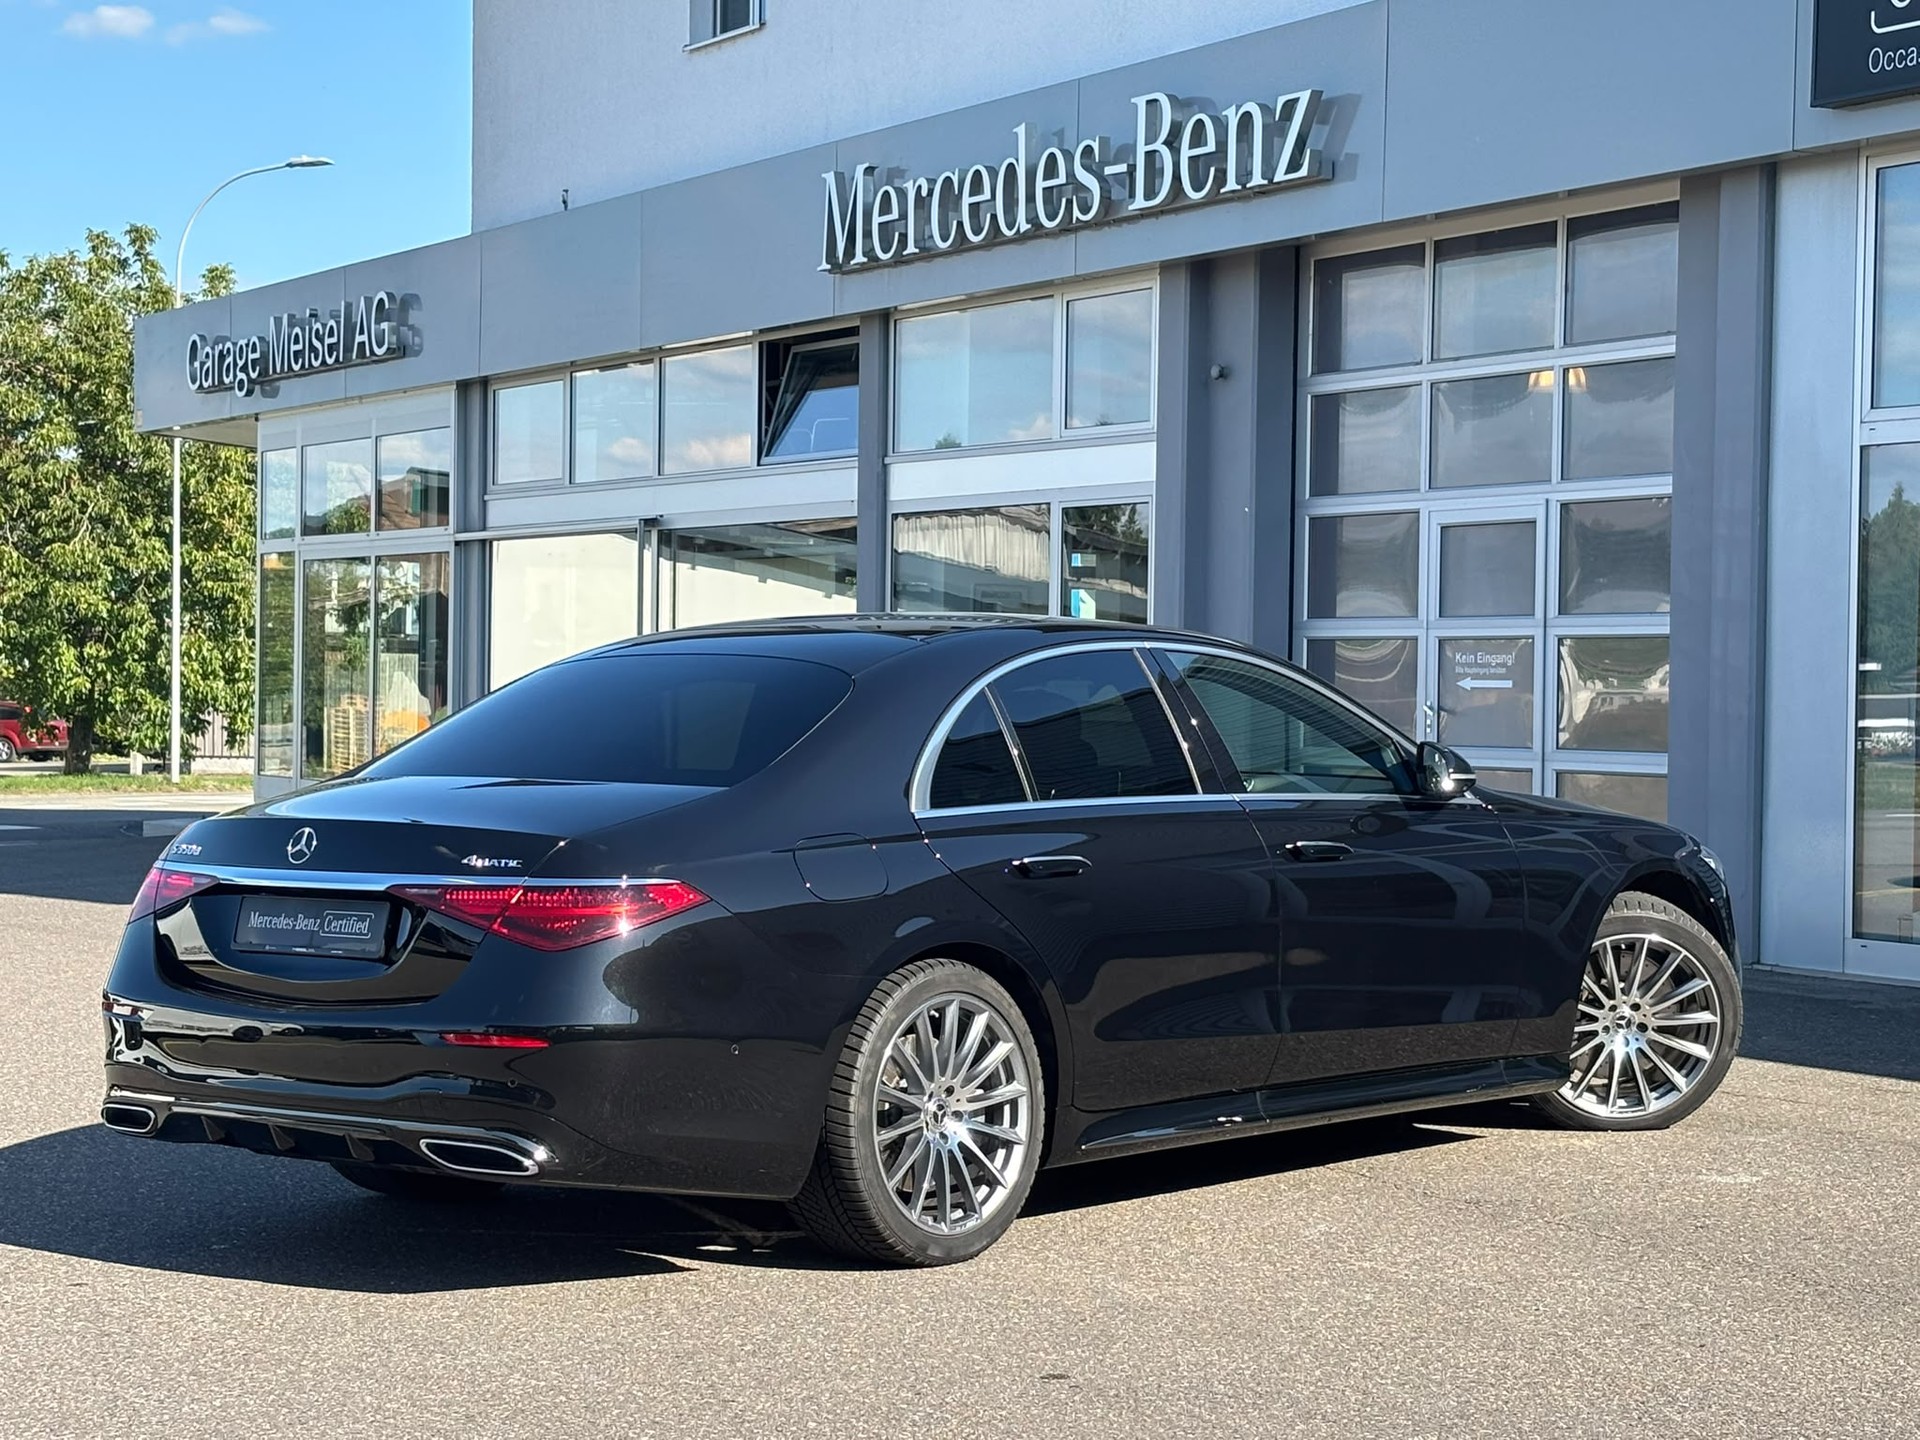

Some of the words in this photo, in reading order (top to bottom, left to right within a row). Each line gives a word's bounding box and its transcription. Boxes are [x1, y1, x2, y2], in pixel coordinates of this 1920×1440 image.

[1868, 46, 1920, 73] Occa
[817, 89, 1320, 273] Mercedes-Benz
[186, 333, 261, 398] Garage
[269, 300, 345, 376] Meisel
[352, 290, 390, 360] AG
[1455, 652, 1475, 664] Kein
[1477, 652, 1515, 666] Eingang!
[461, 854, 523, 868] 4MATIC
[248, 911, 321, 932] Mercedes-Benz
[323, 914, 371, 934] Certified
